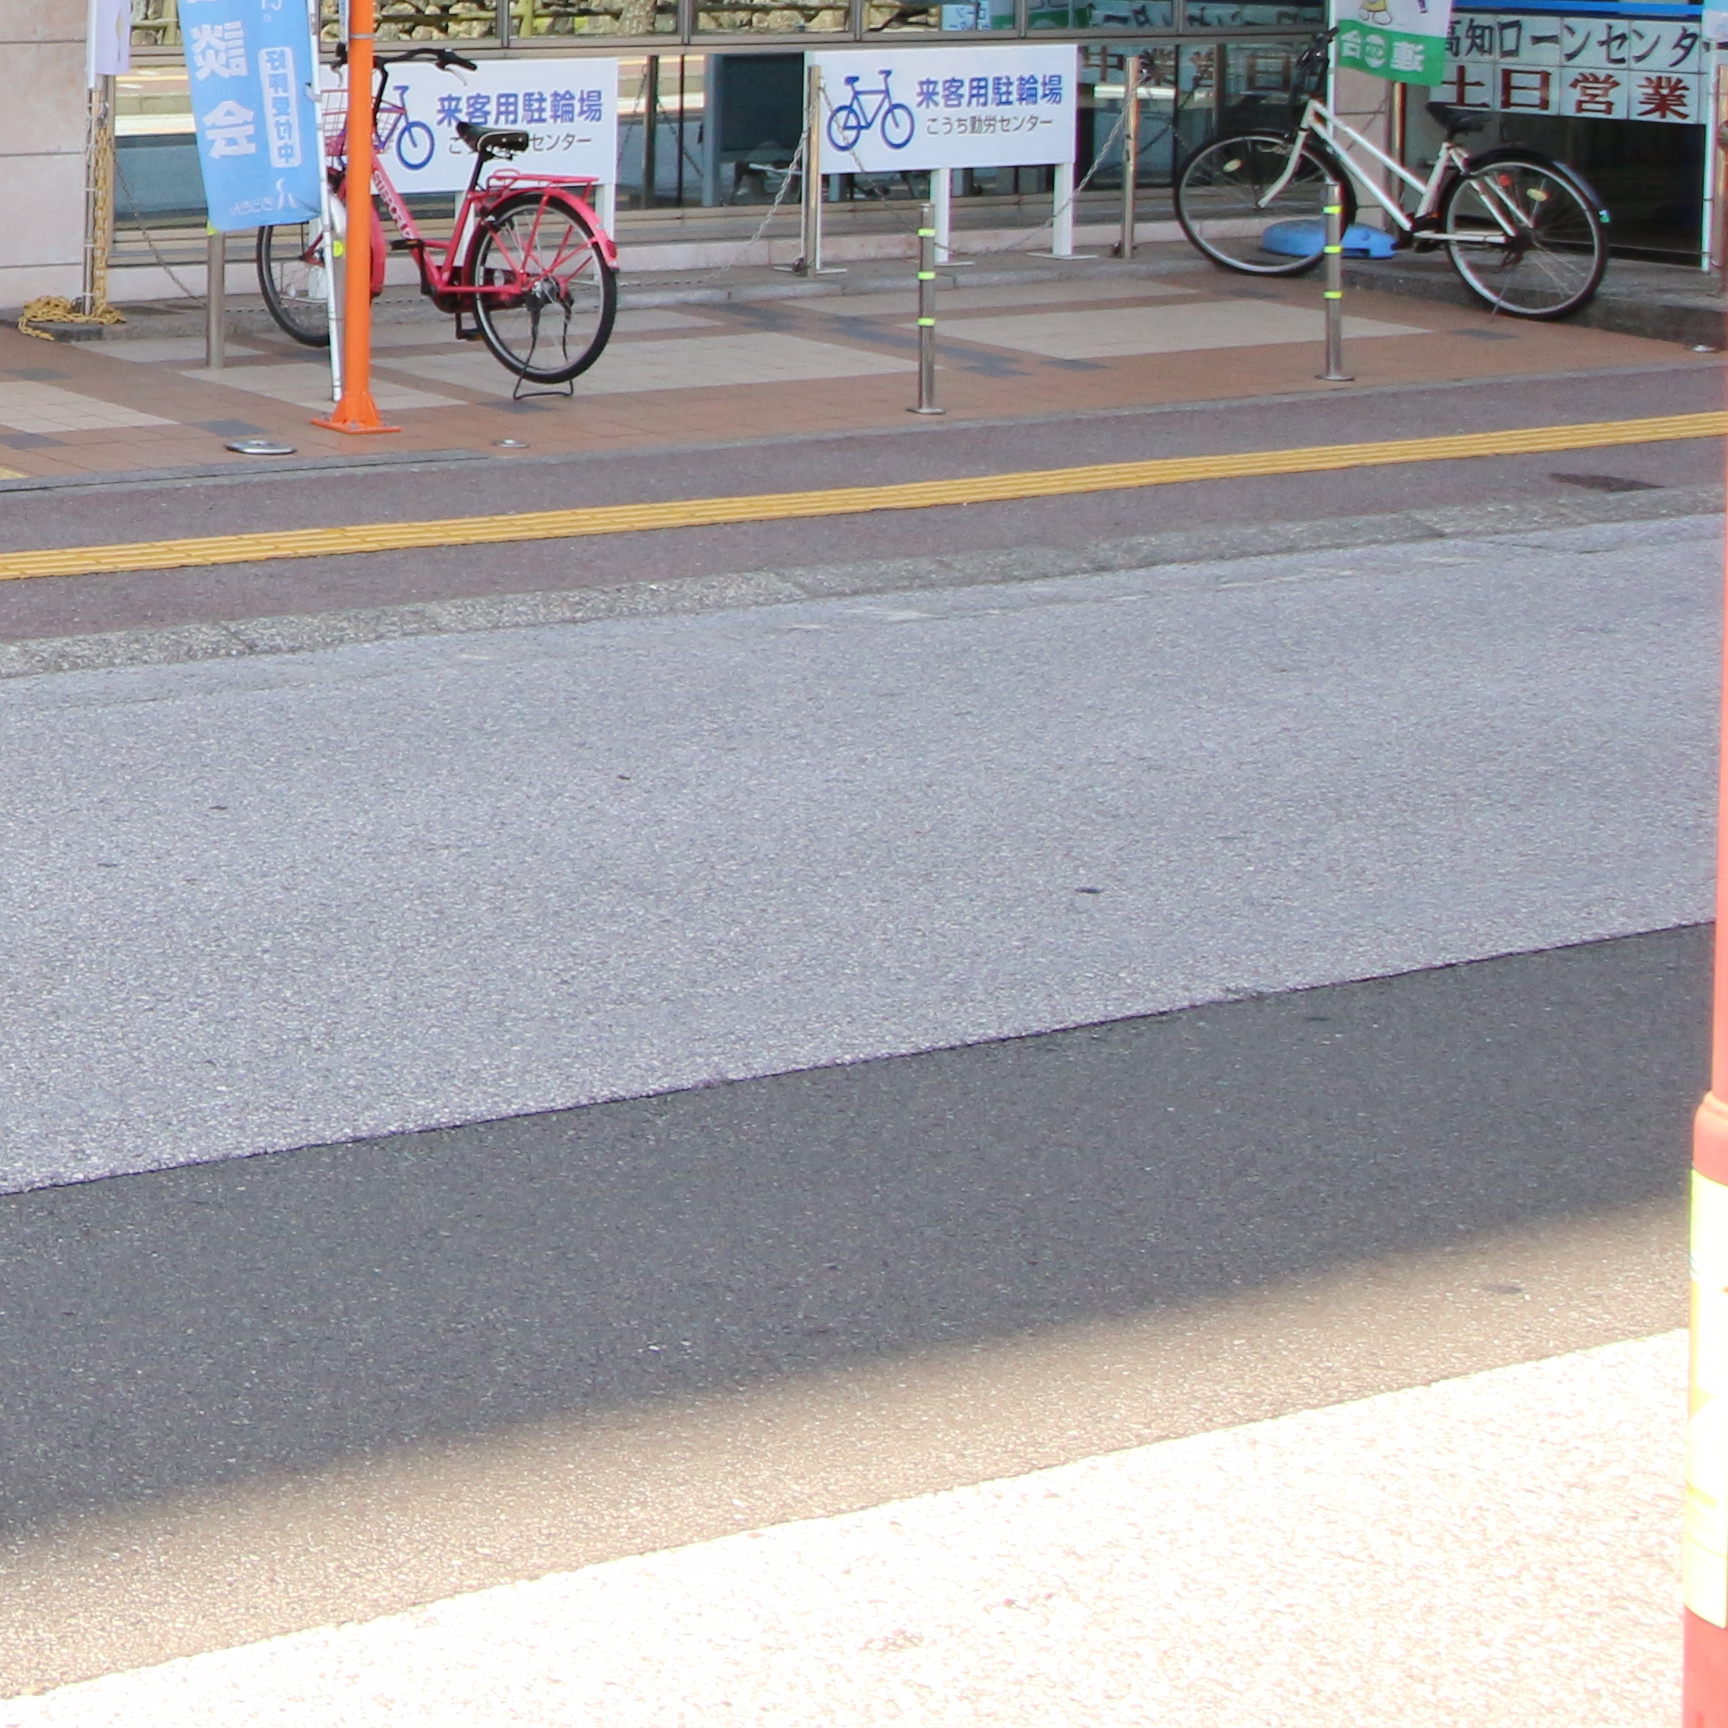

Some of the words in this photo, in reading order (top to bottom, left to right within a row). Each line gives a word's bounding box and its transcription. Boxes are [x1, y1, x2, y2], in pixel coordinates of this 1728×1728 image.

[436, 89, 602, 127] 来客用駐輪場
[916, 75, 1062, 109] 来客用駐輪場
[1441, 65, 1690, 120] 土日営業
[926, 114, 1053, 135] こうち勤労センター
